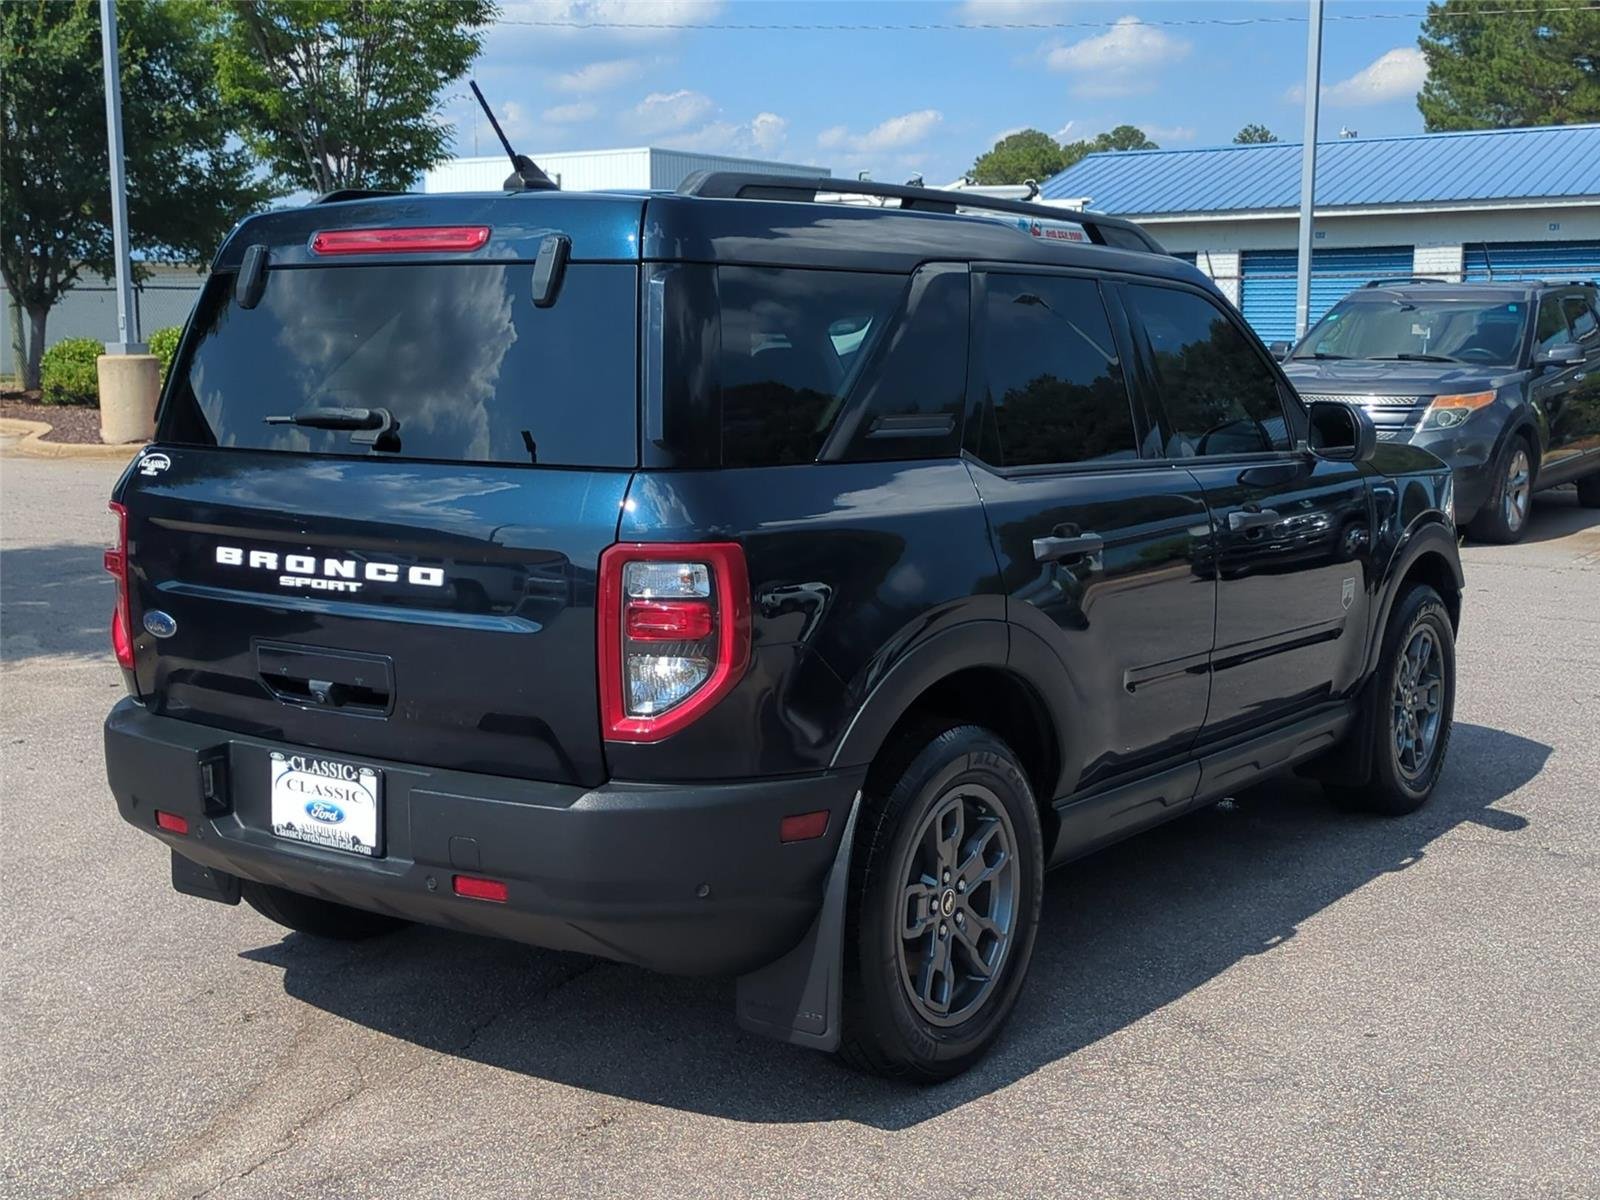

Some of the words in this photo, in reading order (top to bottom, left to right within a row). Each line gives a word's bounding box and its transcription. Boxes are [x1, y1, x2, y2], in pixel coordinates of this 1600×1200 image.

[215, 546, 444, 587] BRONCO
[279, 575, 363, 592] SPORT
[290, 755, 355, 781] CLASSIC
[286, 778, 364, 805] CLASSIC
[309, 801, 340, 822] Ford
